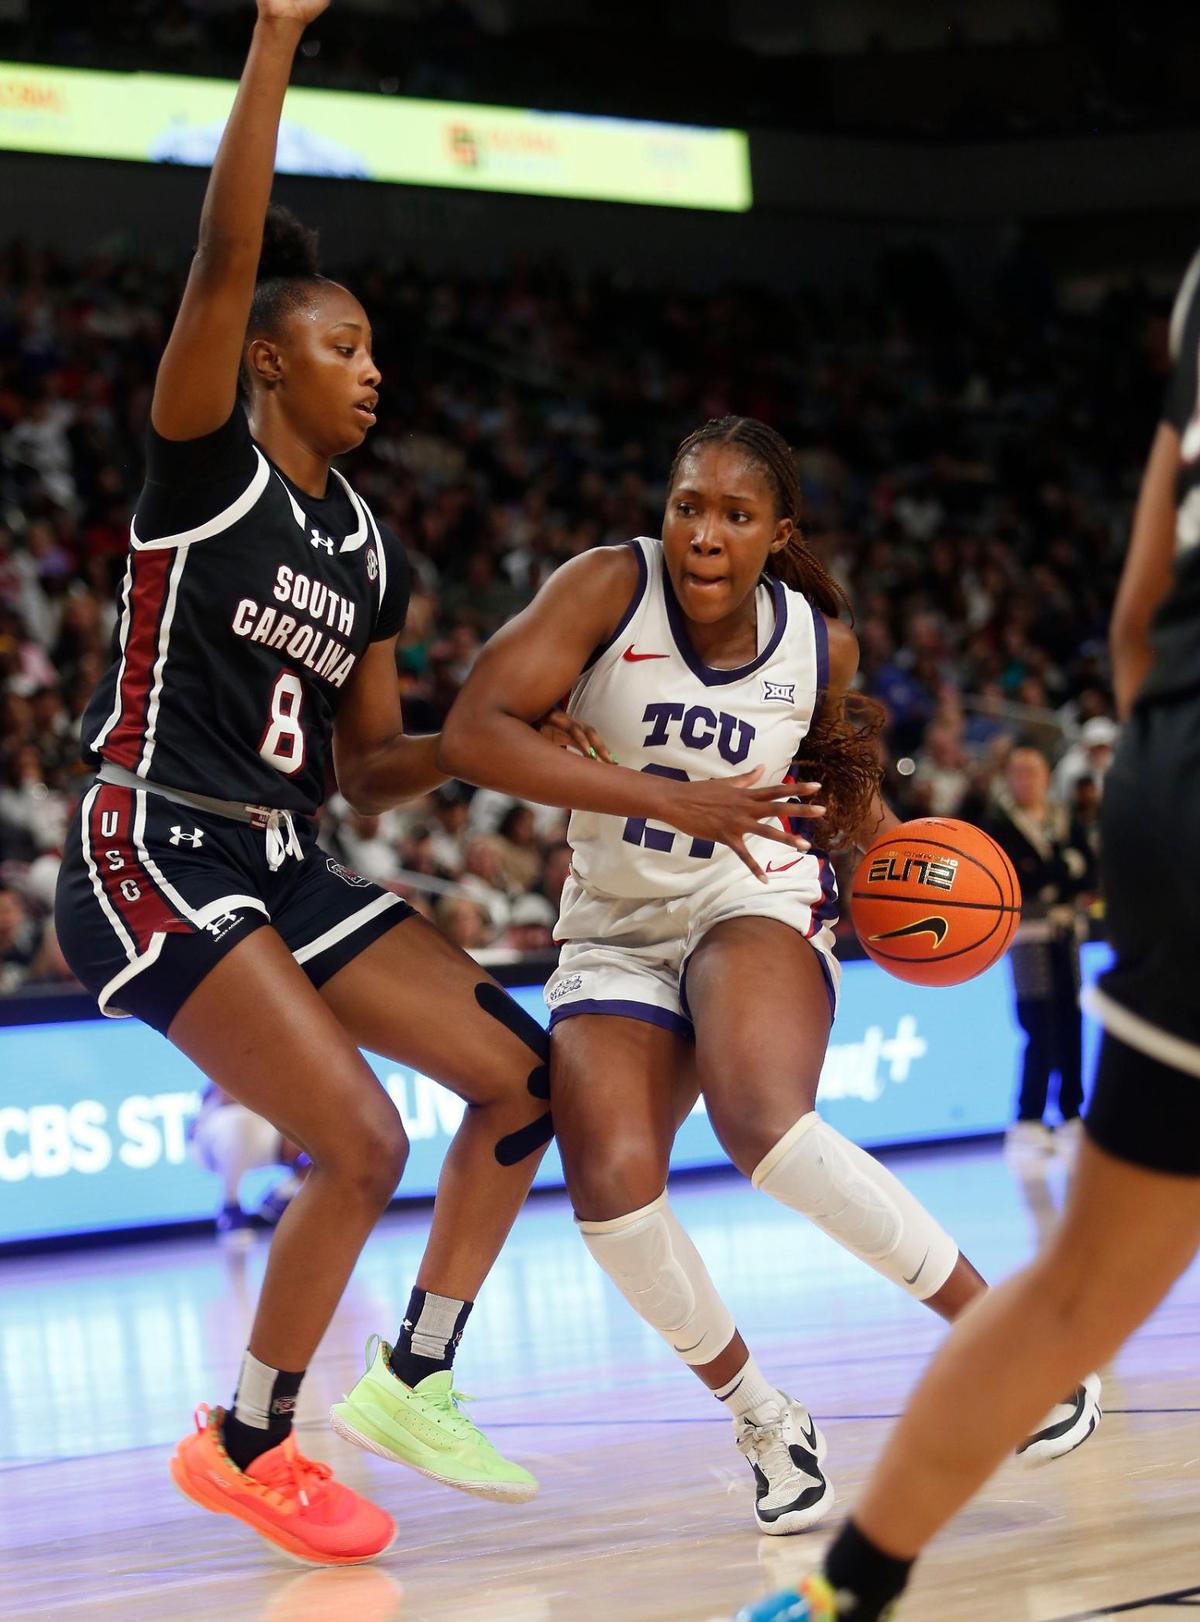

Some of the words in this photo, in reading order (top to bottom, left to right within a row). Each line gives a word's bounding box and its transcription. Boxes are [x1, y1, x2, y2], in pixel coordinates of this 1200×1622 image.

[273, 565, 355, 637] SOUTH
[232, 598, 356, 688] CAROLINA
[258, 670, 306, 776] 8
[641, 703, 756, 766] TCU
[868, 858, 957, 892] ELITE
[0, 1099, 112, 1182] CBS
